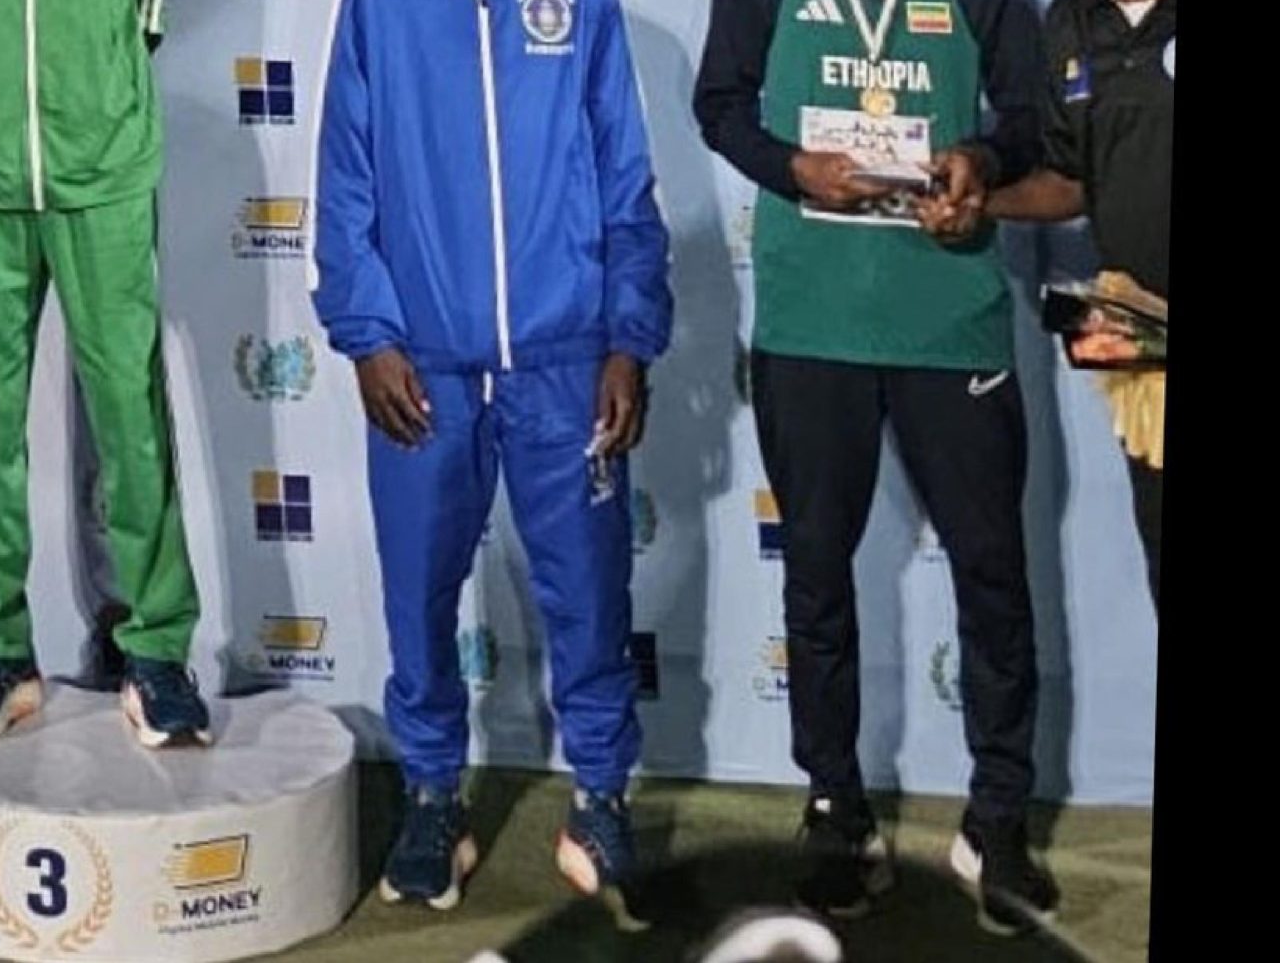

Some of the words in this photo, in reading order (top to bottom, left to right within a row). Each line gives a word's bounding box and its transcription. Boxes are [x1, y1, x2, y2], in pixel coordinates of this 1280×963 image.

[821, 55, 933, 92] ETHIOPIA
[25, 847, 68, 918] 3
[152, 884, 262, 922] D-MONEY
